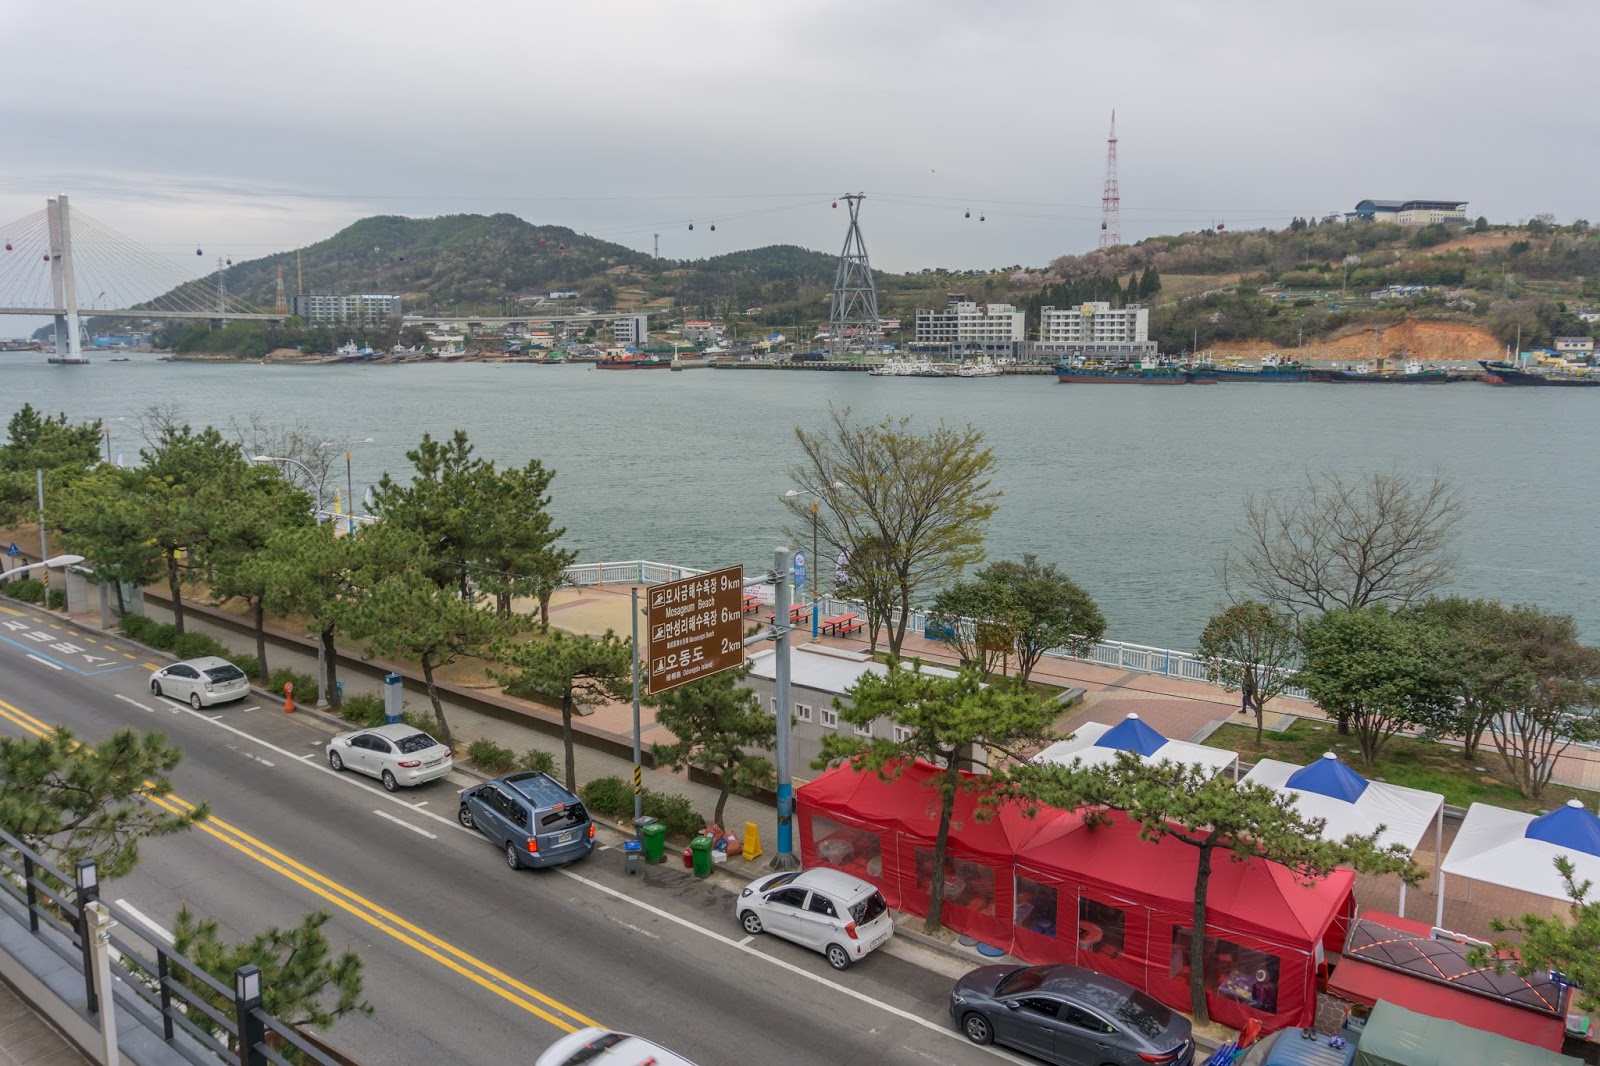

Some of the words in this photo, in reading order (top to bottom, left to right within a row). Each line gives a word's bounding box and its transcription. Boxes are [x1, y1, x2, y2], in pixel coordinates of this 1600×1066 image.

[665, 577, 717, 604] 모사금해수욕장
[665, 602, 695, 618] Mosageum
[697, 596, 715, 610] Beach
[665, 609, 717, 639] 만성리해수욕장
[665, 646, 704, 670] 오동도
